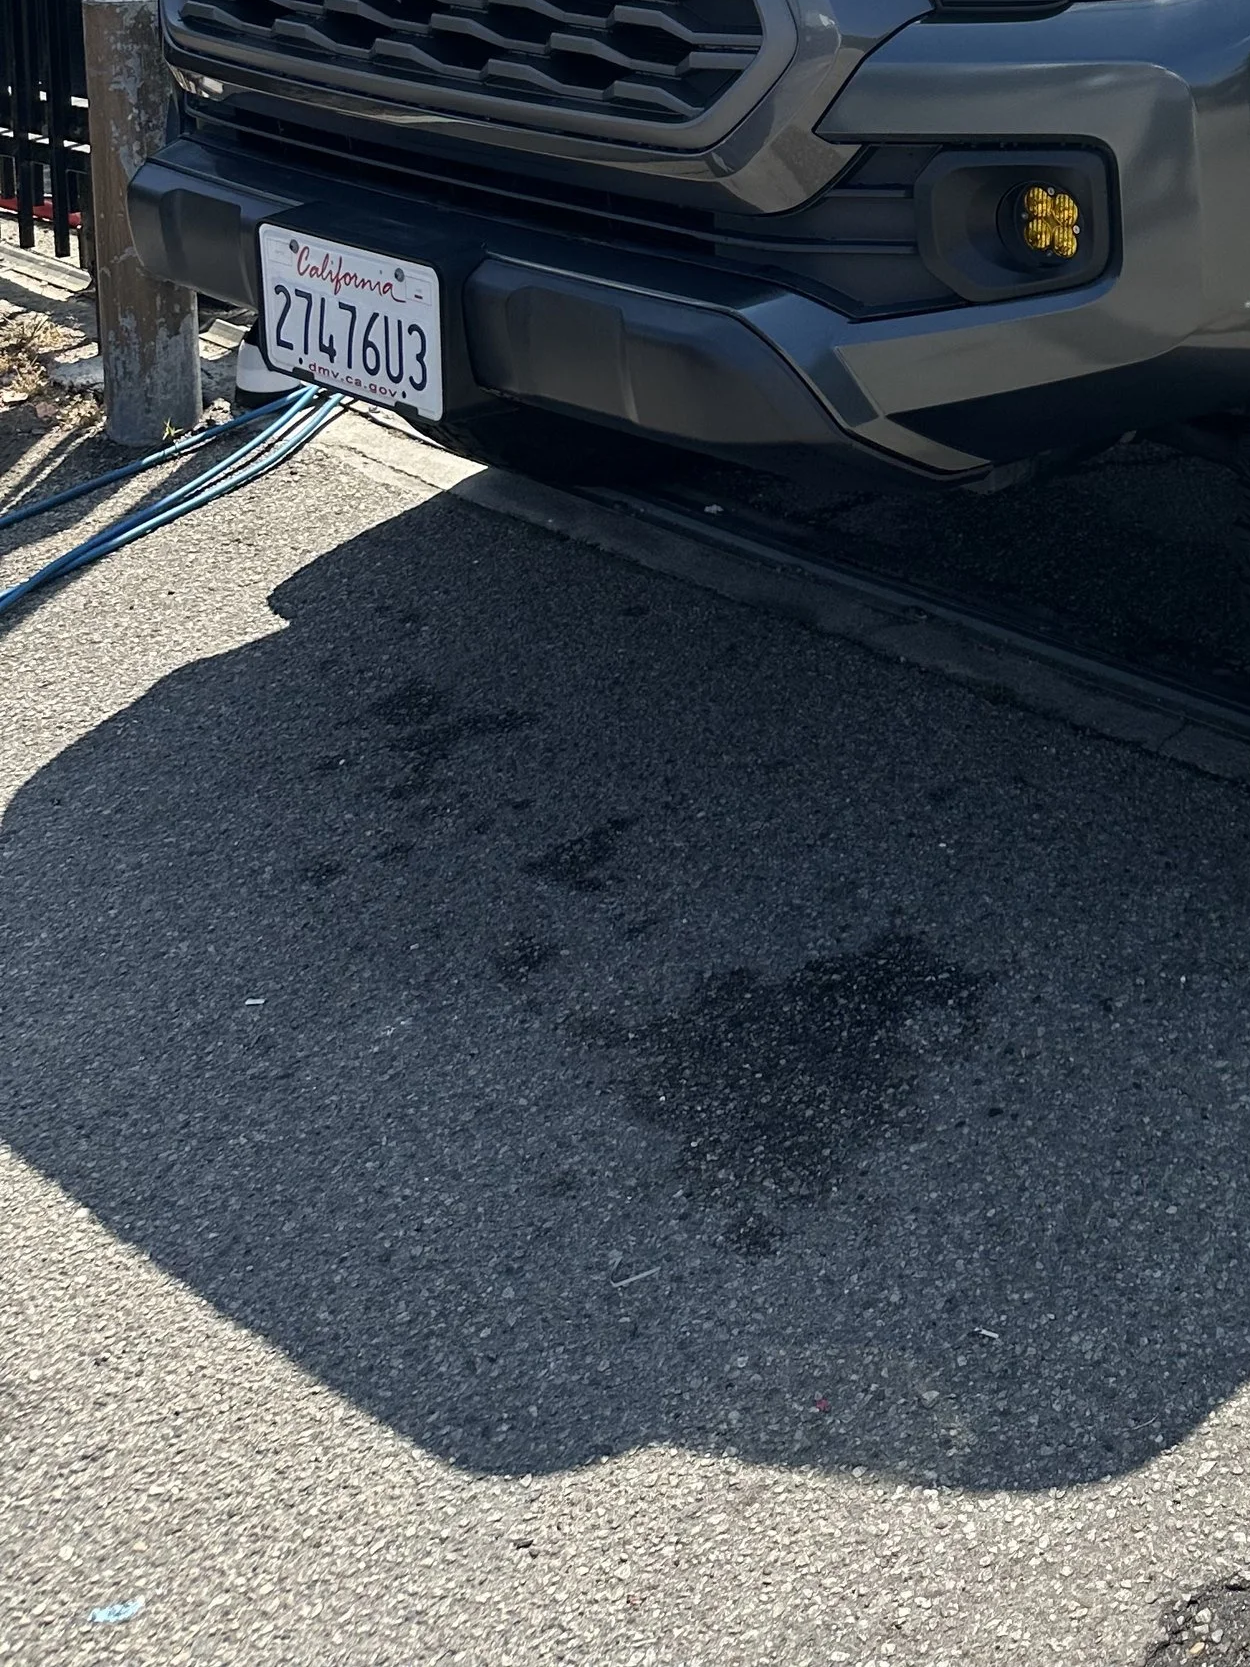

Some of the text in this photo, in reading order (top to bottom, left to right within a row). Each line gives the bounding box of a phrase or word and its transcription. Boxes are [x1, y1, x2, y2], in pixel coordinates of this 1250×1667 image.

[296, 245, 407, 304] California
[274, 284, 428, 392] 27476U3
[308, 362, 398, 400] dmv.ca.gov
